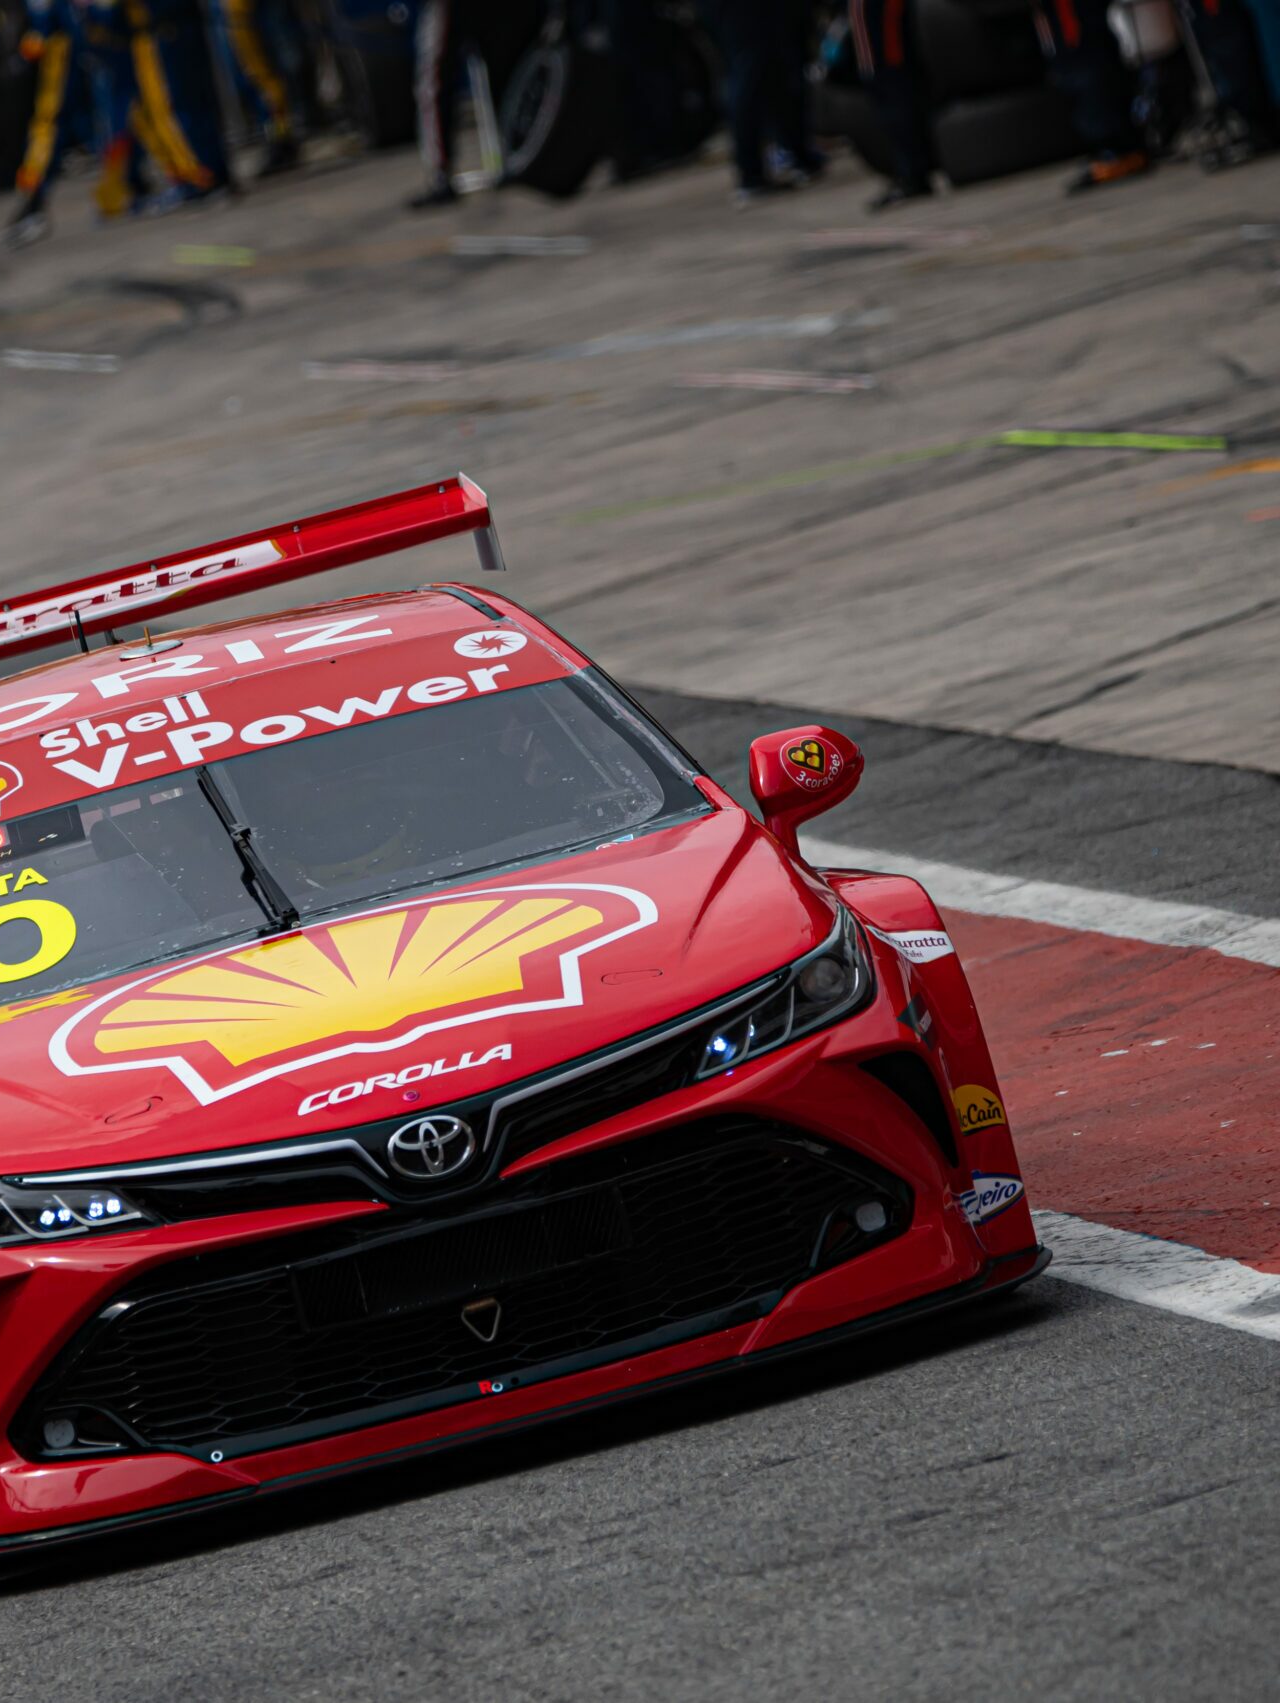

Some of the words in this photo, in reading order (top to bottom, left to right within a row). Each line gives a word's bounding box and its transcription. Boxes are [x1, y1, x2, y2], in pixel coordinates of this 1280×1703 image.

[39, 690, 212, 759] Shell
[52, 663, 510, 789] V-Power
[796, 770, 807, 782] 3
[297, 1043, 512, 1116] COROLLA
